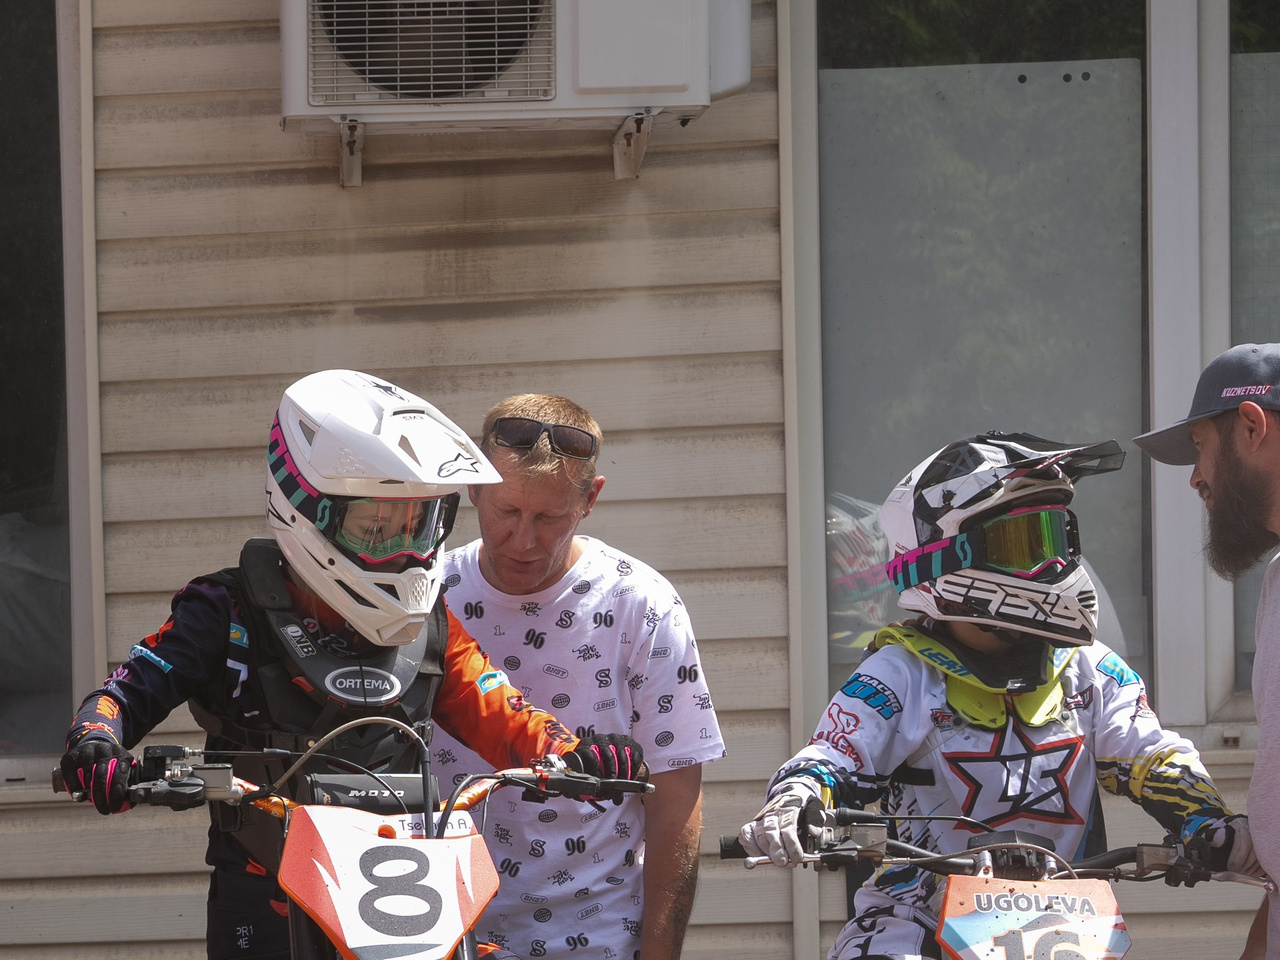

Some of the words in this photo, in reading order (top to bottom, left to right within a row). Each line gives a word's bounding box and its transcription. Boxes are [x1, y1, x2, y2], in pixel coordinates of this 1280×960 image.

[1221, 385, 1272, 397] KUZNETSOV
[464, 601, 484, 620] 96
[555, 609, 575, 629] S
[593, 609, 615, 629] 96
[523, 628, 547, 649] 96
[918, 647, 972, 677] LEATT
[595, 668, 612, 688] S
[677, 663, 698, 684] 96
[336, 678, 391, 690] ORTEMA
[858, 674, 902, 714] RACING
[657, 694, 674, 713] S
[348, 790, 405, 798] MOTO
[458, 818, 471, 830] A.
[528, 839, 546, 857] S
[564, 835, 586, 856] 96
[498, 857, 522, 878] 96
[358, 845, 443, 937] 8
[974, 893, 1097, 917] UGOLEVA
[530, 939, 547, 957] S
[565, 932, 589, 951] 96
